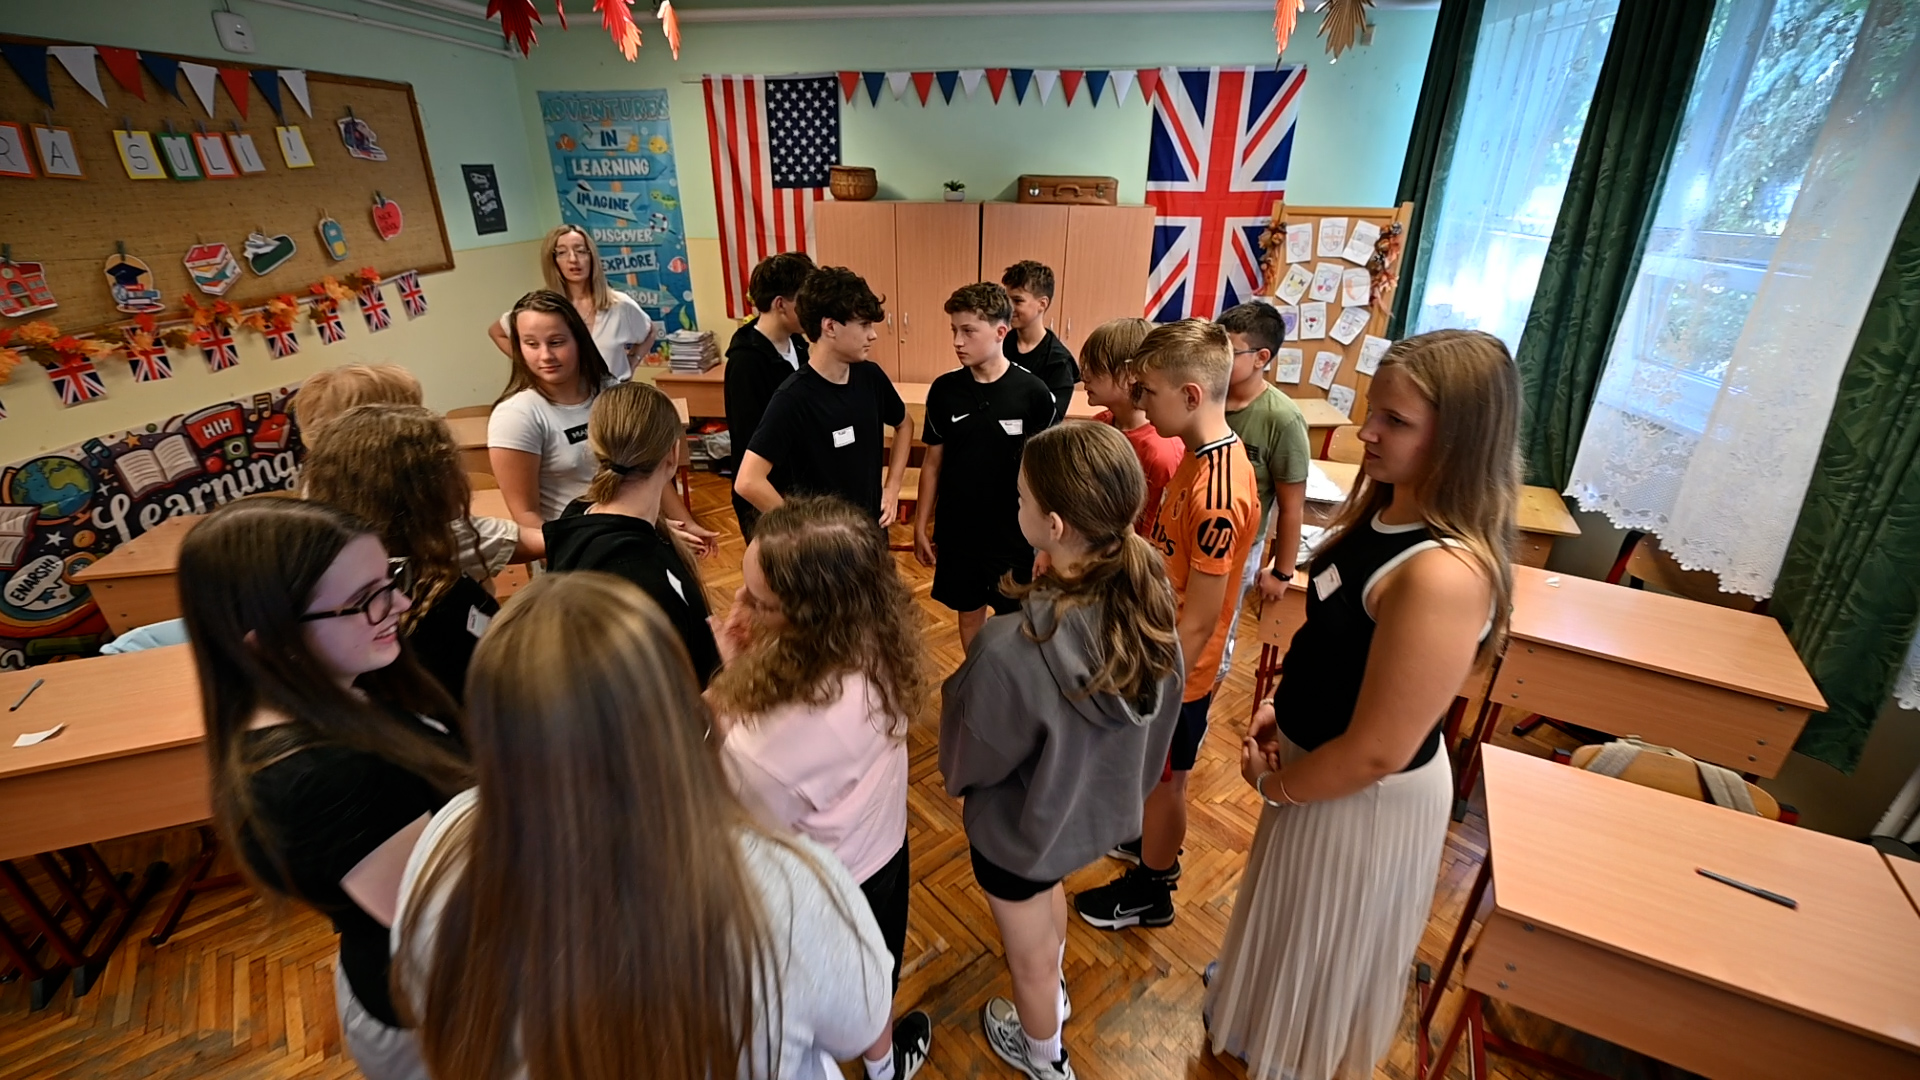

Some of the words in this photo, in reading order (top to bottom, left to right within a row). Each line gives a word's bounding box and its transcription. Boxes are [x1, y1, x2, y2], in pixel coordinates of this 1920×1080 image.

[541, 97, 669, 122] ADVENTURES
[600, 129, 618, 147] IN
[127, 143, 253, 171] SULI
[571, 158, 650, 176] LEARNING
[576, 191, 630, 212] IMAGINE
[593, 228, 653, 243] DISCOVER
[201, 417, 233, 440] HIH
[91, 450, 302, 546] Learning
[1198, 516, 1233, 559] hp
